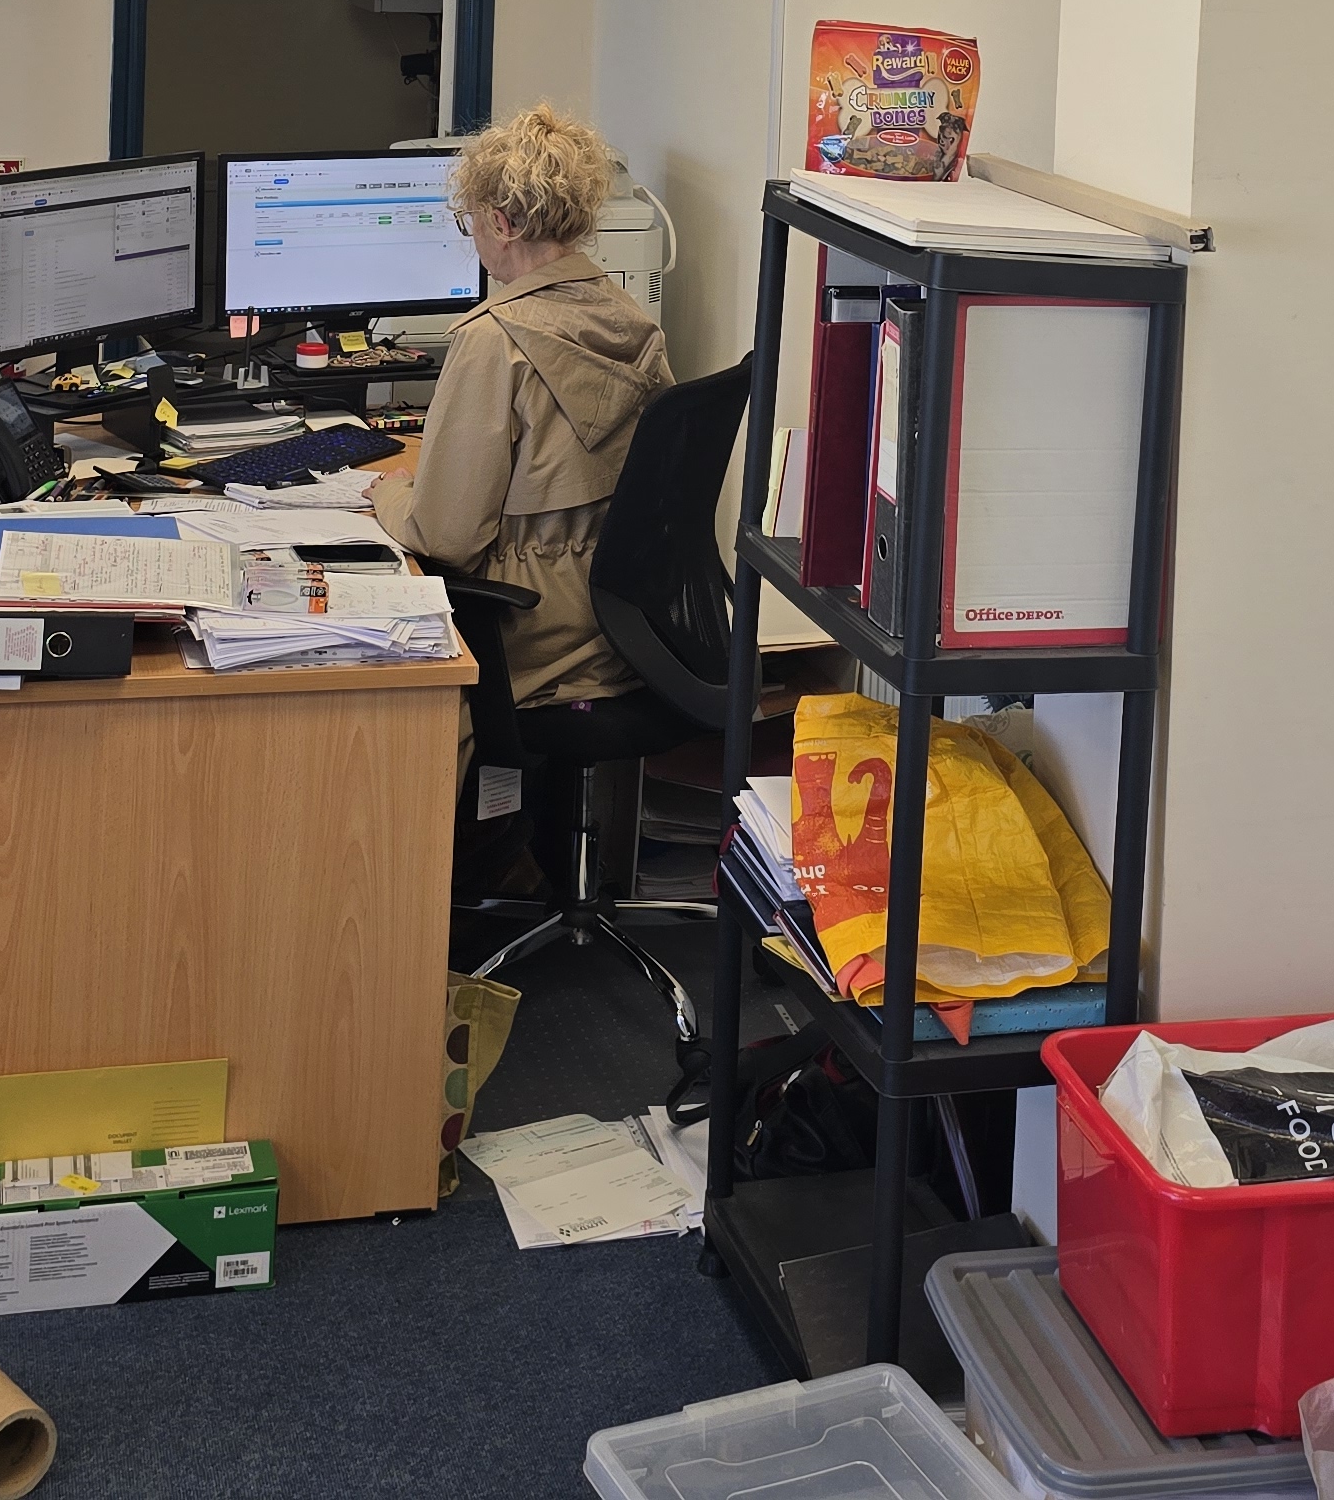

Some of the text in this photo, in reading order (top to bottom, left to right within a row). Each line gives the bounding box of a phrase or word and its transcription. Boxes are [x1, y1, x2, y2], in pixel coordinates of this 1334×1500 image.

[873, 52, 926, 72] Reward
[945, 57, 971, 68] VALUE
[946, 65, 968, 76] PACK
[964, 607, 1063, 622] Office DEPOT
[228, 1203, 269, 1217] Lexmark
